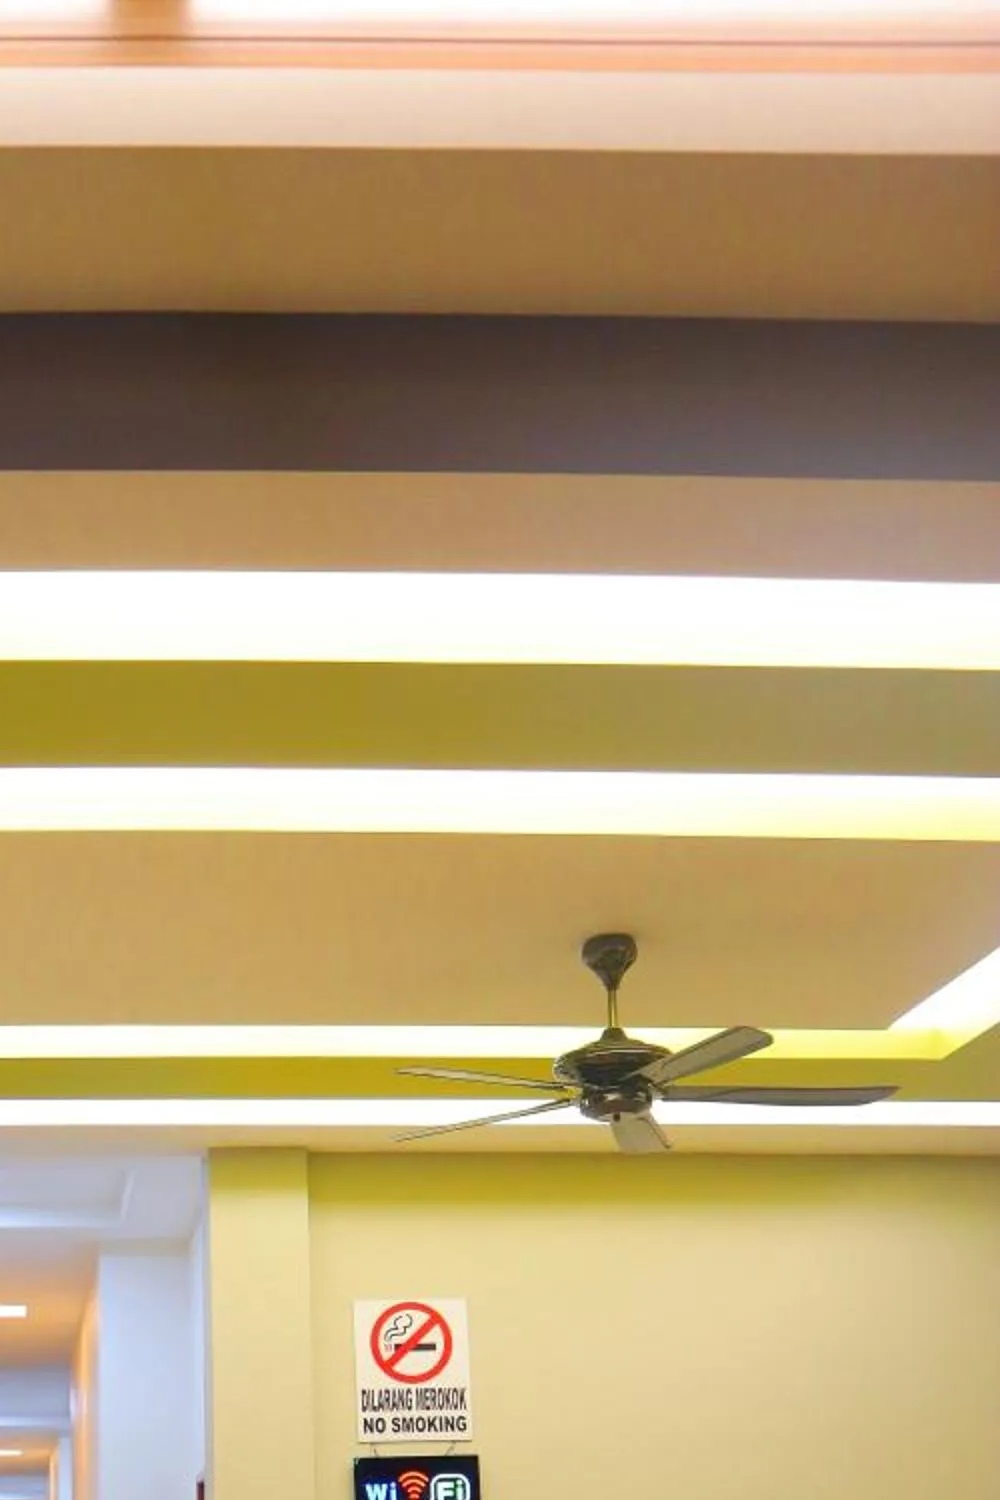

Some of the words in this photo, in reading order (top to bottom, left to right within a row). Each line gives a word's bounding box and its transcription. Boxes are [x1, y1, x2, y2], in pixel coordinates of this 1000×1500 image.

[361, 1388, 412, 1412] DILARANG
[415, 1387, 467, 1411] MEROKOK
[363, 1417, 387, 1434] NO
[391, 1415, 467, 1433] SMOKING
